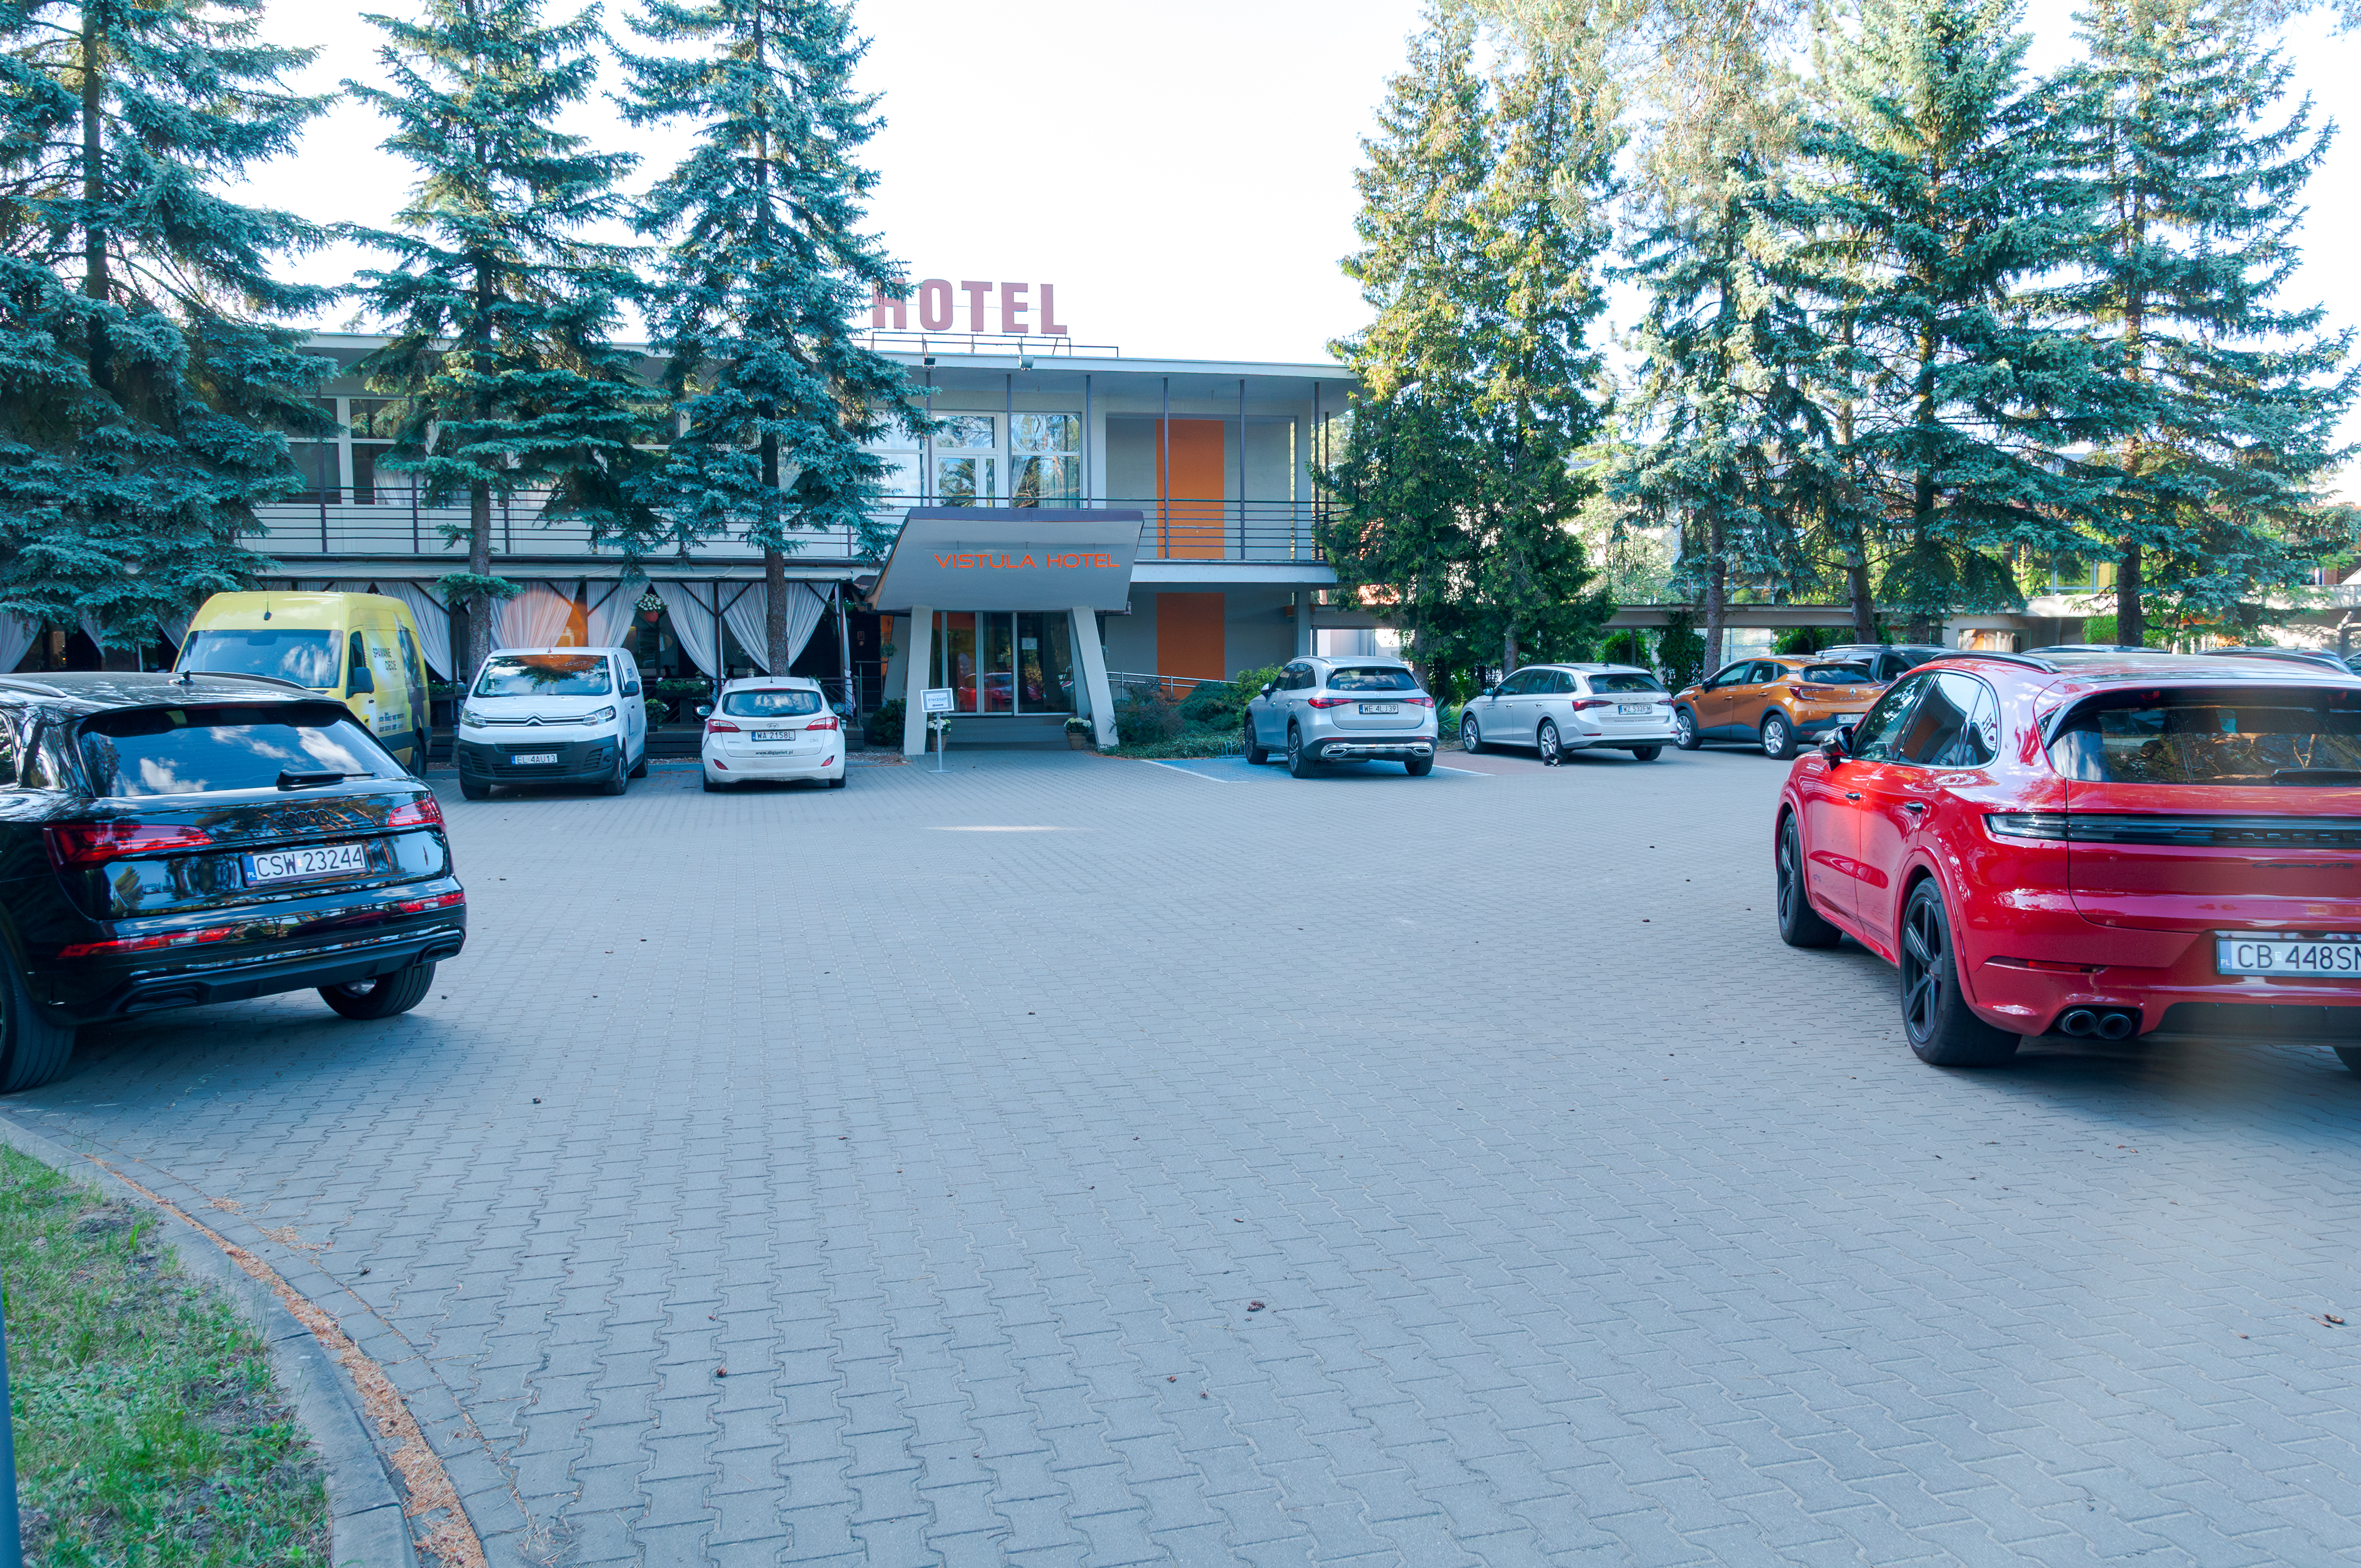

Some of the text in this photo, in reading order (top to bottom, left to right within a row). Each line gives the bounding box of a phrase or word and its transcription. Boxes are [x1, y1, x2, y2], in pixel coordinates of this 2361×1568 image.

[873, 279, 1067, 334] HOTEL
[934, 553, 1120, 568] VISTULA HOTEL
[257, 846, 363, 877] CSW 23244
[2238, 944, 2273, 968] CB
